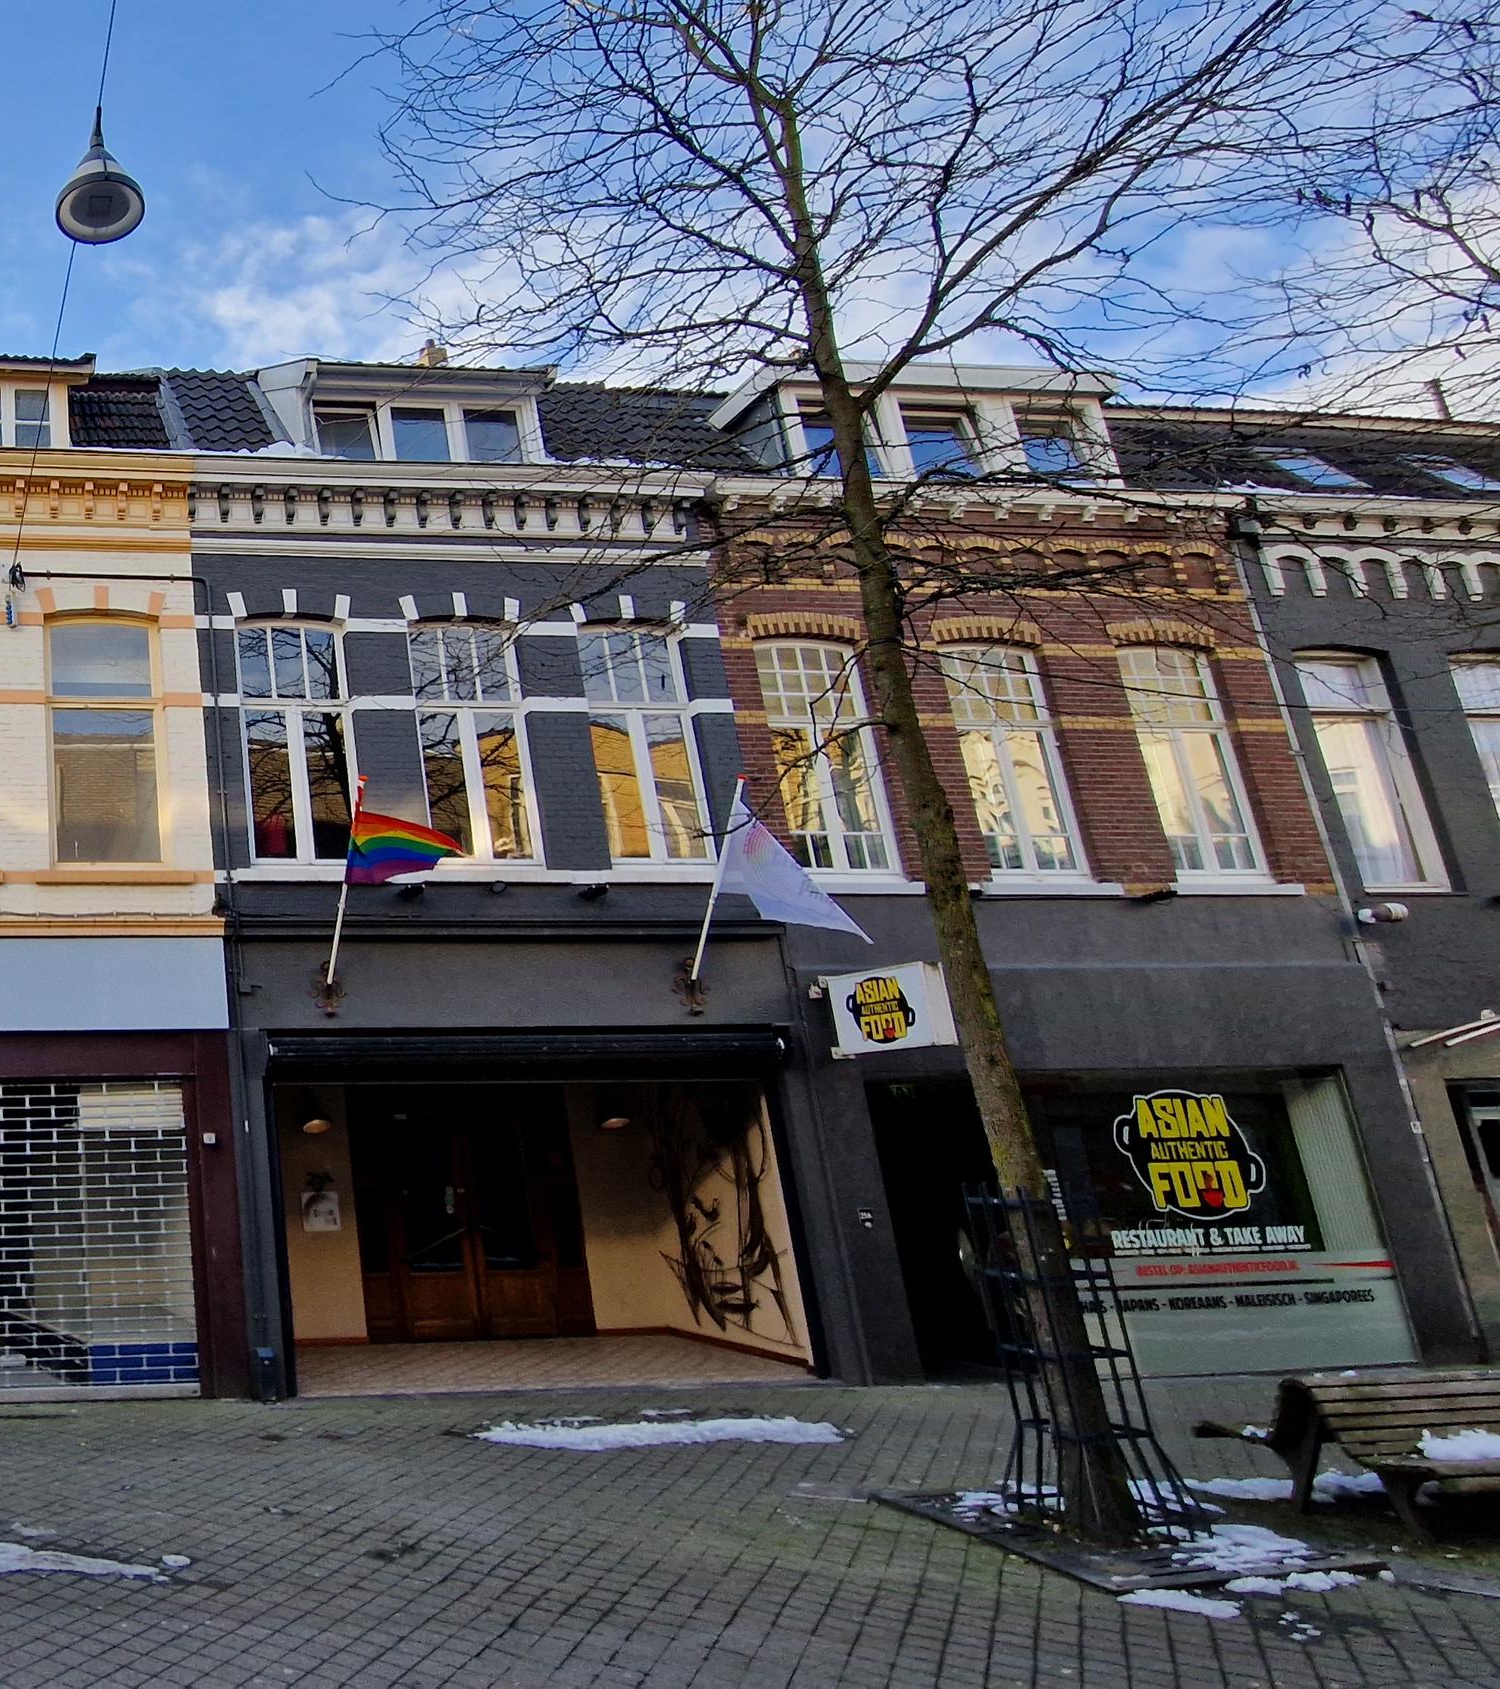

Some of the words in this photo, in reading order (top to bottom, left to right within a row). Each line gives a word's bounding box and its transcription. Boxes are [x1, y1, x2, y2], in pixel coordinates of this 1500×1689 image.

[855, 976, 900, 1005] ASIAN
[861, 1000, 899, 1015] AUTHENTIC
[860, 1011, 907, 1041] FOOD
[1136, 1098, 1230, 1138] ASIAN
[1150, 1140, 1229, 1160] AUTHENTIC
[1147, 1160, 1249, 1208] FOOD
[1110, 1227, 1205, 1249] RESTAURANT
[1209, 1228, 1225, 1245] &
[1224, 1226, 1263, 1245] TAKE
[1265, 1225, 1306, 1244] AWAY
[1168, 1295, 1228, 1311] KOREAANS
[1234, 1292, 1297, 1308] MALEISISCH
[1303, 1288, 1375, 1305] SINGAPOREES
